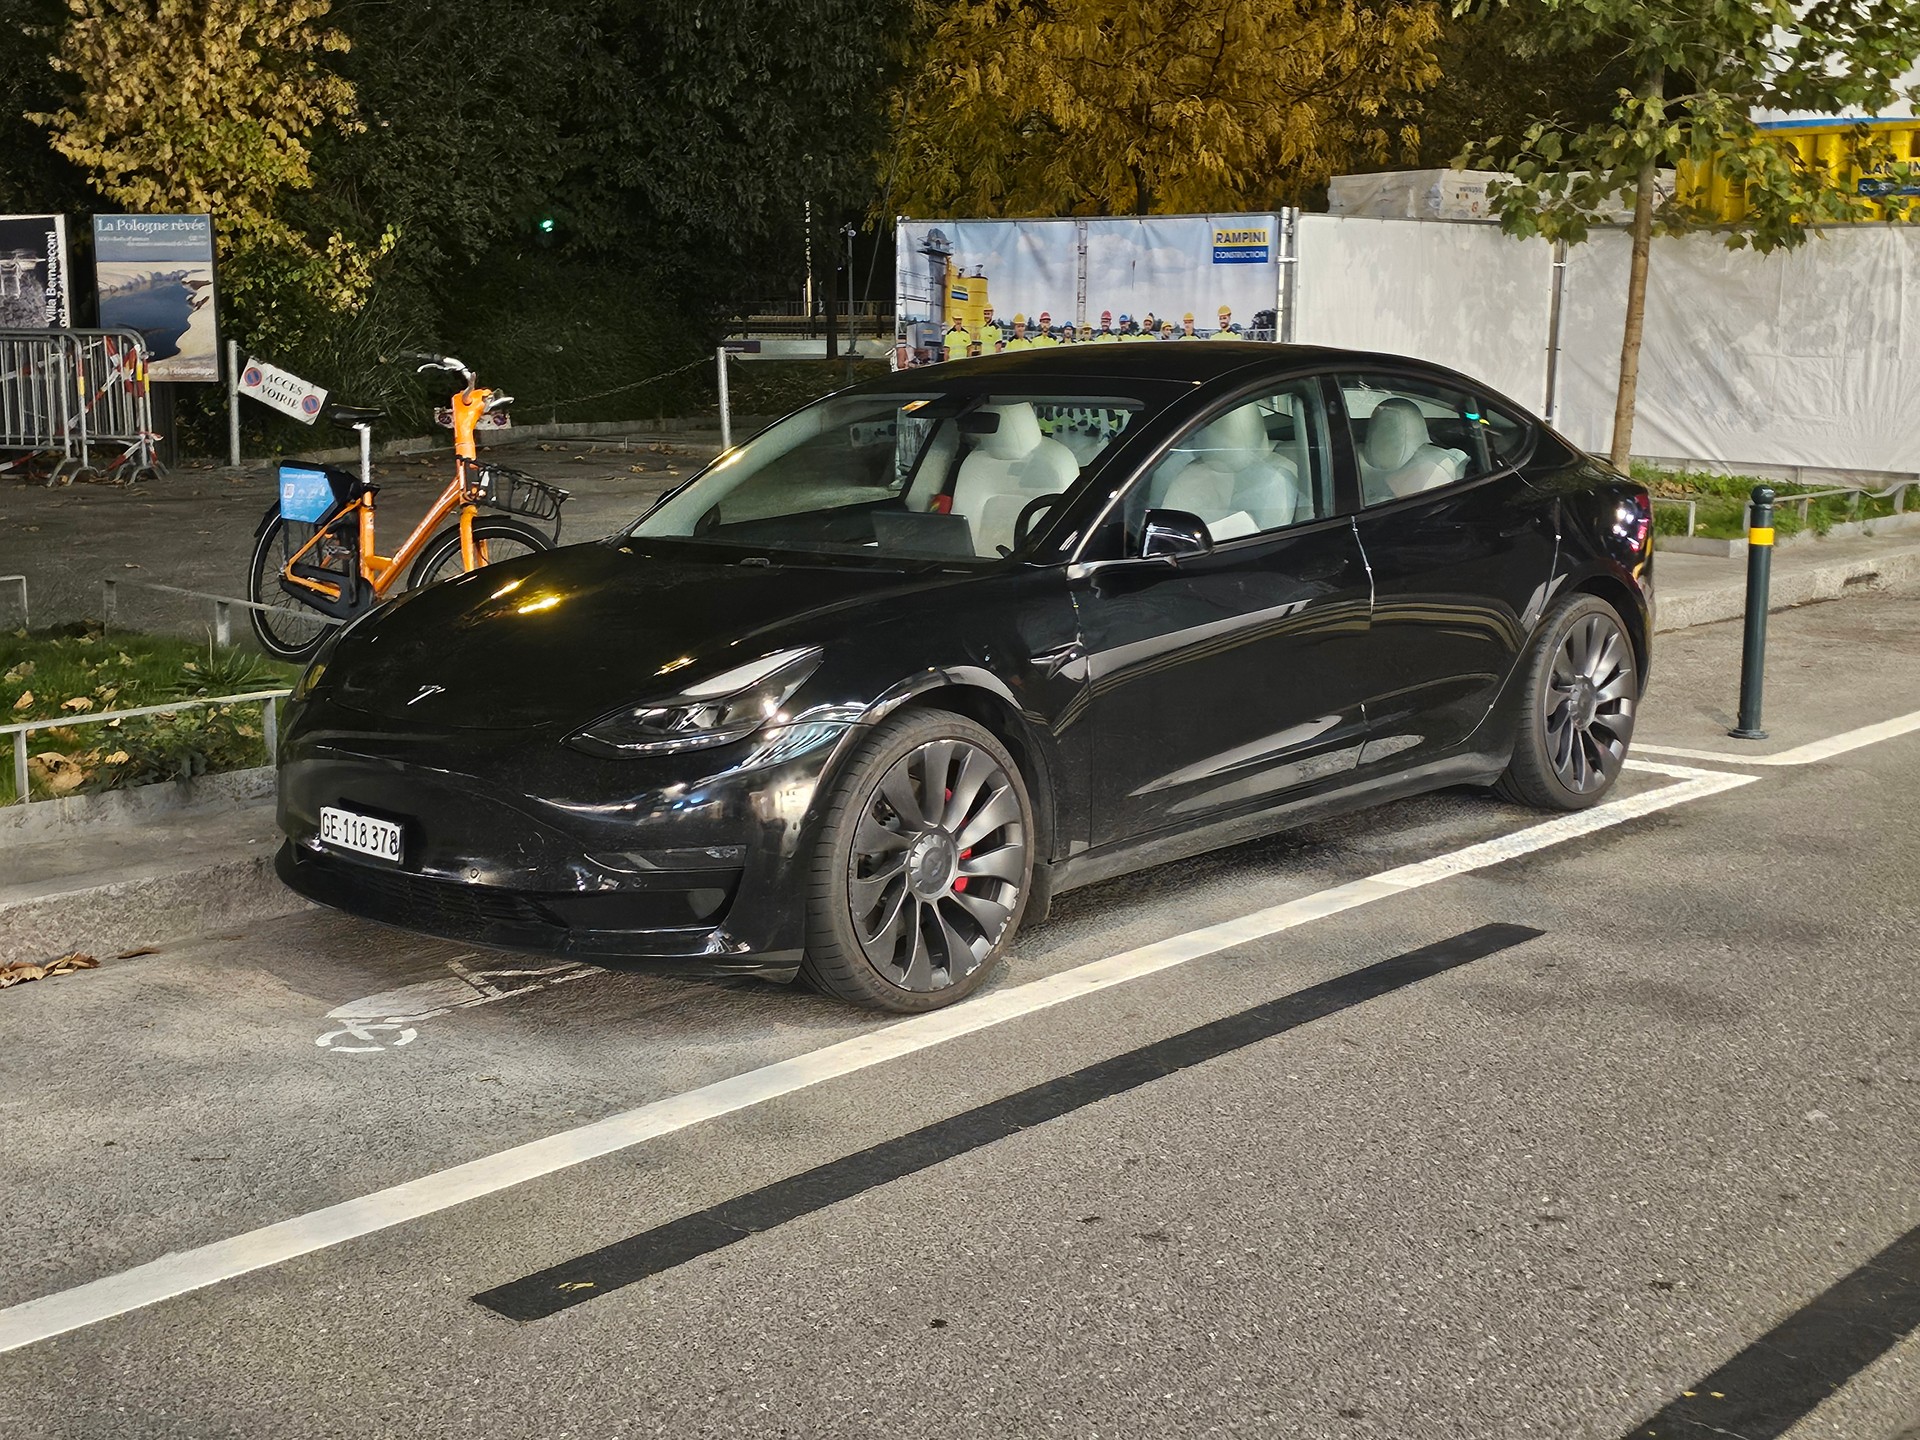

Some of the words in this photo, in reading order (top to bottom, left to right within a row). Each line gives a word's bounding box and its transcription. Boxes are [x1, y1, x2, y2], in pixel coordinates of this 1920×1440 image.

[98, 219, 114, 231] La
[117, 218, 169, 234] Pologne
[171, 218, 206, 231] rêvée
[1216, 231, 1266, 243] RAMPINI
[1215, 251, 1266, 259] CONSTRUCTION
[46, 299, 57, 323] Villa
[266, 373, 304, 396] ACCES
[261, 384, 299, 410] VOIRIE
